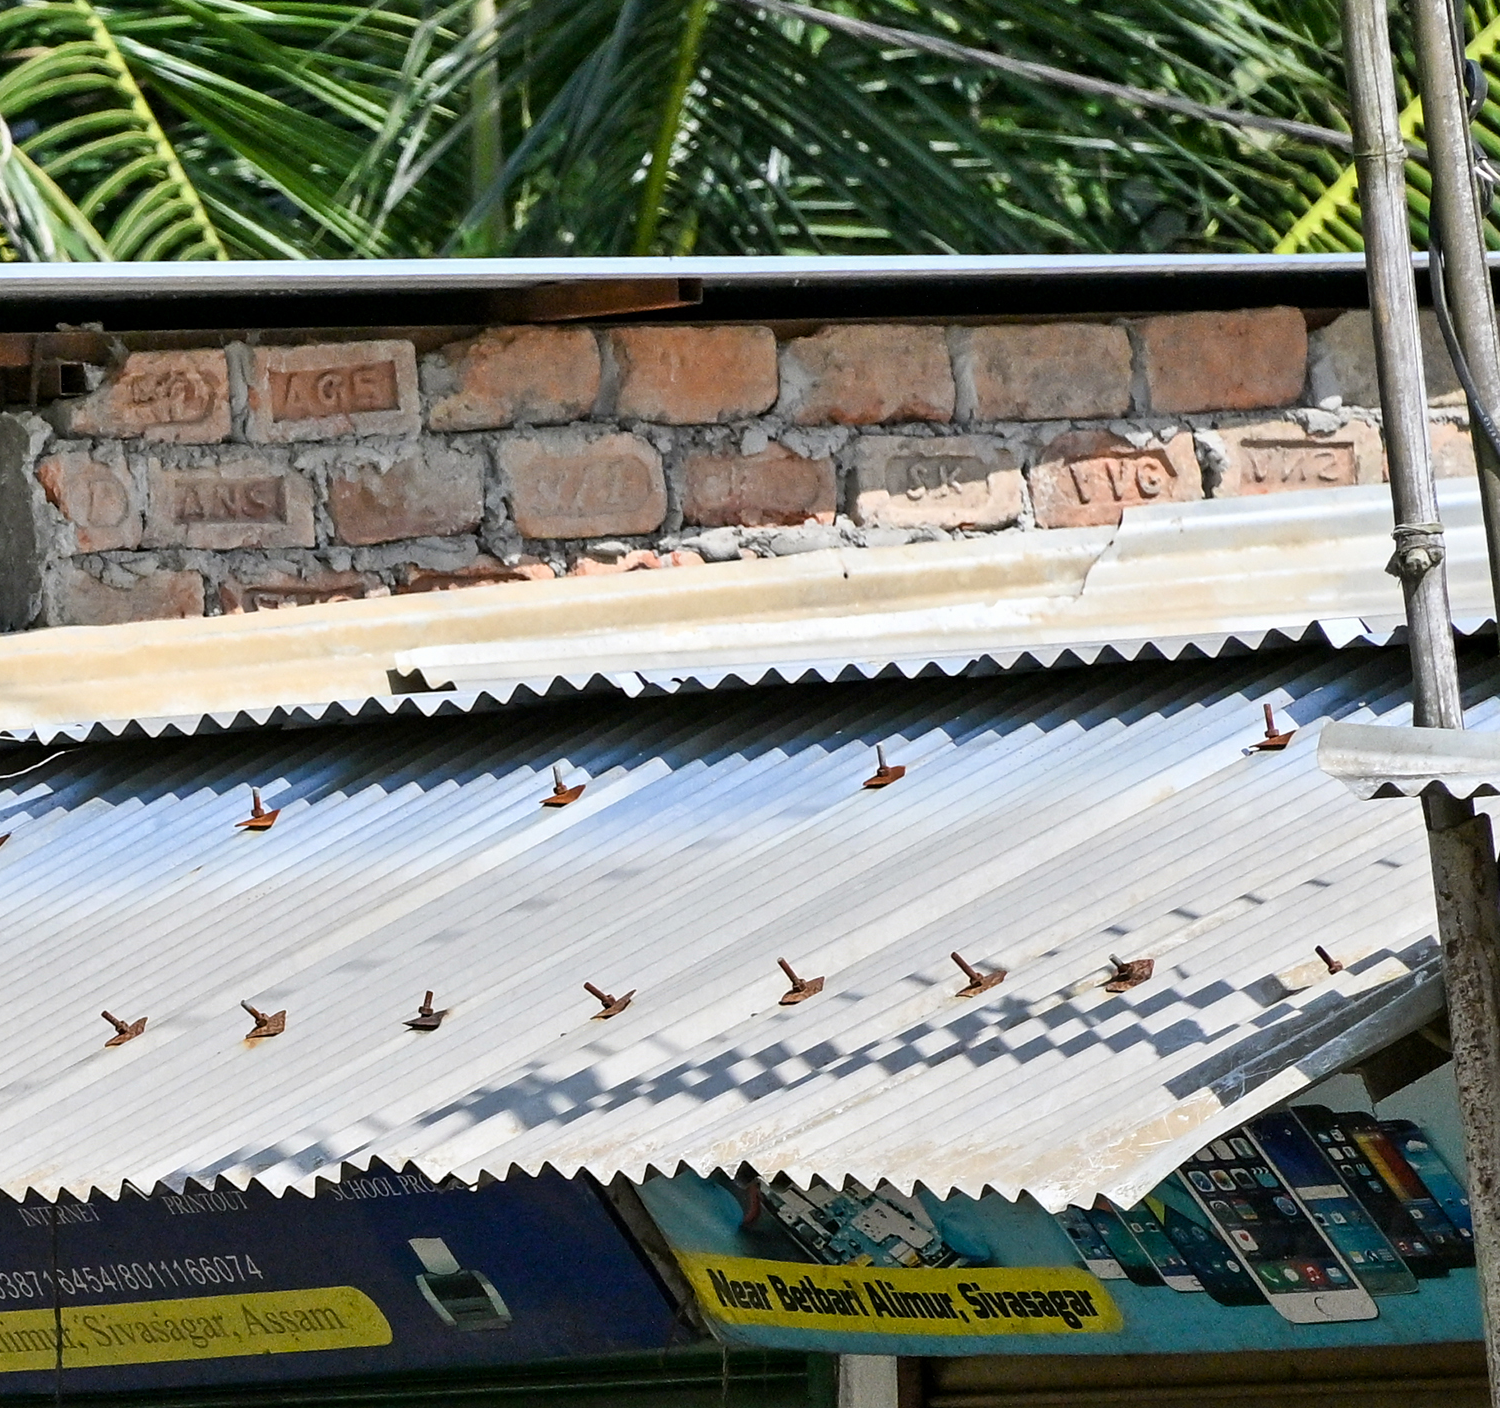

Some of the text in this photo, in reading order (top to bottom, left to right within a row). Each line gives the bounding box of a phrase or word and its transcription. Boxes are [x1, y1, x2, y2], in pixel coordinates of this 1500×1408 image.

[163, 1190, 249, 1217] PRINTOUT
[329, 1174, 400, 1202] SCHOOL
[706, 1268, 1100, 1330] Near Betbari Alimur, Sivasagar
[245, 1302, 347, 1340] Assam
